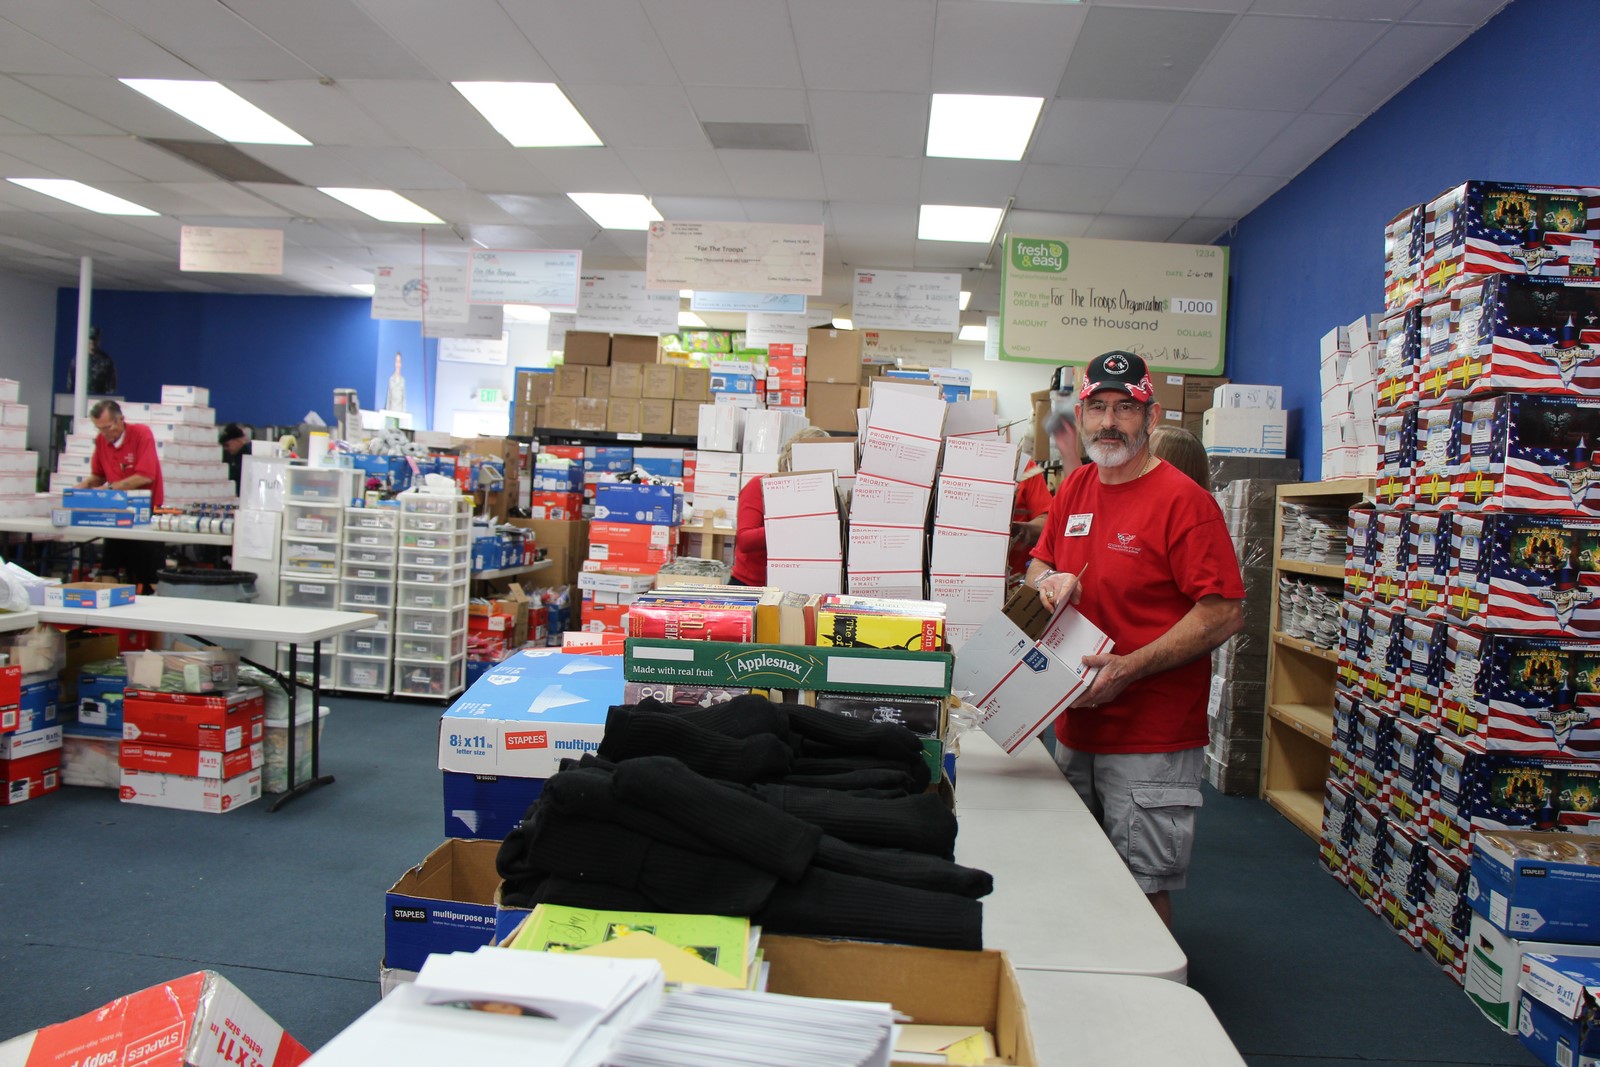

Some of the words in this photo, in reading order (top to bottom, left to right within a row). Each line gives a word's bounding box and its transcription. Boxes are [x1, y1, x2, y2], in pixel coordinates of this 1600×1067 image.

[1018, 243, 1049, 256] fresh
[1195, 248, 1216, 257] 1234
[1022, 255, 1032, 267] &
[1032, 255, 1062, 271] easy
[1013, 299, 1040, 307] ORDER
[1051, 287, 1064, 306] For
[1069, 288, 1085, 308] The
[1087, 287, 1117, 313] Troops
[1178, 300, 1213, 314] 1,000
[1012, 319, 1048, 328] AMOUNT
[1061, 316, 1088, 327] one
[1092, 315, 1159, 331] thousand
[1177, 328, 1213, 338] DOLLARS
[481, 389, 497, 403] EXIT
[869, 431, 900, 441] PRIORITY
[868, 438, 896, 448] PRIORITY
[845, 620, 854, 638] The
[926, 624, 935, 647] John
[1046, 625, 1061, 646] PRIORITY
[836, 634, 844, 646] of
[737, 654, 802, 674] Applesnax
[632, 665, 655, 674] Made
[657, 667, 676, 675] with
[678, 668, 694, 676] real
[696, 668, 713, 677] fruit
[985, 709, 999, 722] MAIL
[464, 737, 472, 748] x
[473, 736, 486, 748] 11
[508, 735, 546, 745] STAPLES
[456, 748, 472, 756] letter
[473, 748, 486, 756] size
[394, 909, 426, 919] STAPLES
[432, 910, 483, 922] multipurpose
[1520, 912, 1530, 920] 96
[210, 1021, 220, 1034] in
[225, 1017, 243, 1036] size
[128, 1030, 179, 1060] STAPLES
[216, 1031, 236, 1062] 11
[242, 1034, 263, 1057] letter
[82, 1050, 118, 1067] copy
